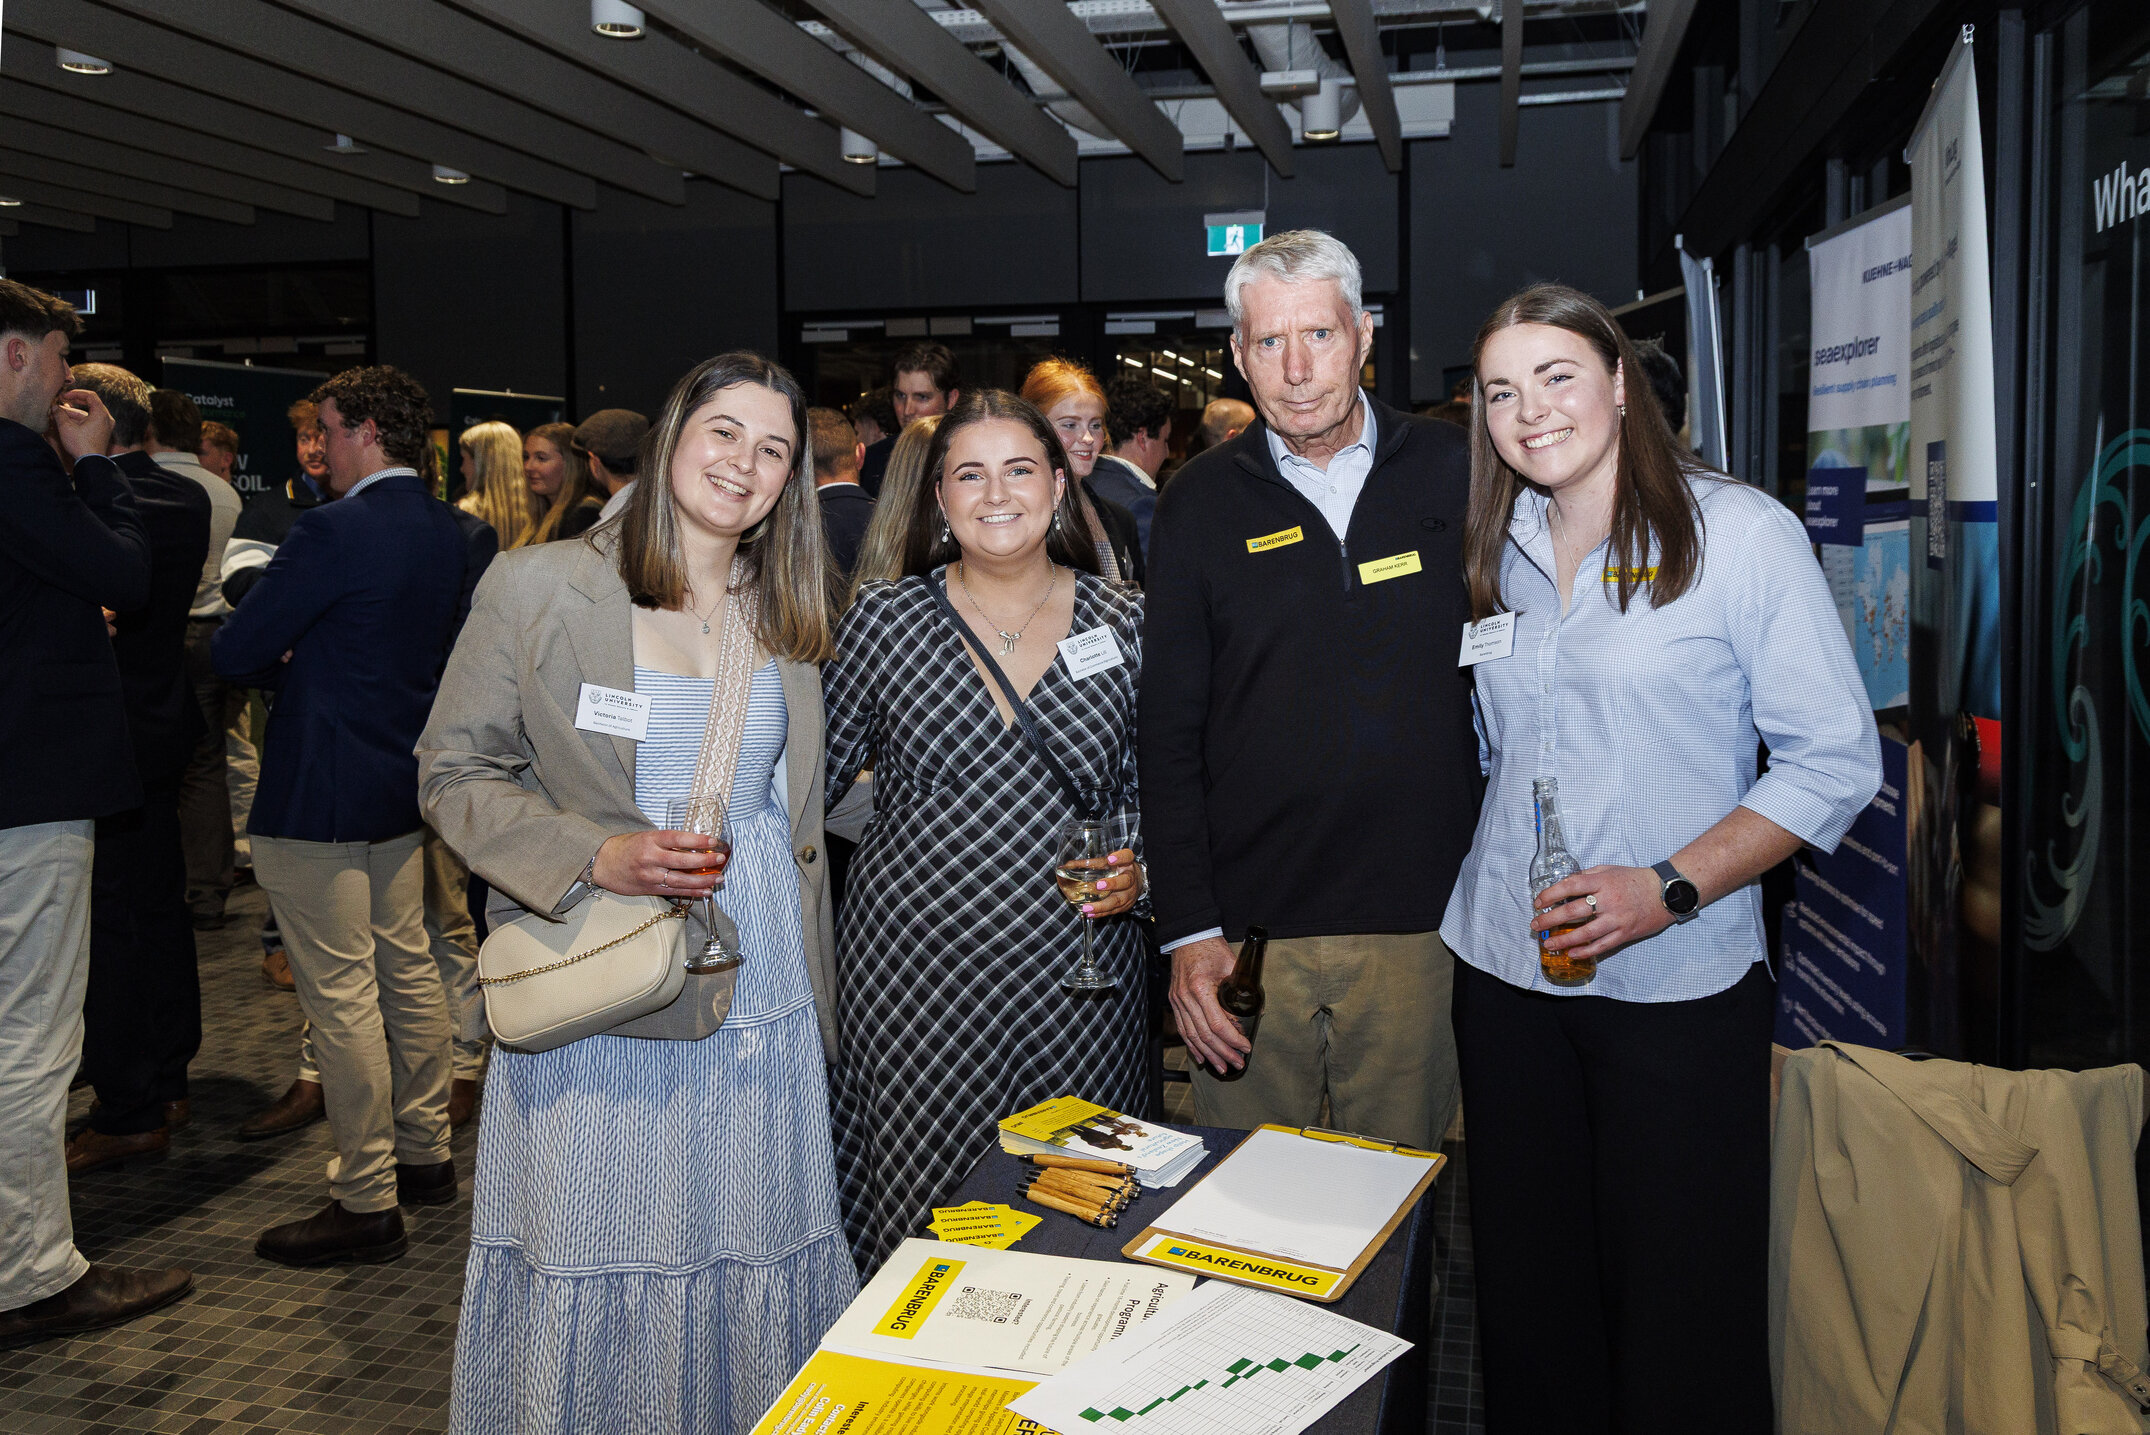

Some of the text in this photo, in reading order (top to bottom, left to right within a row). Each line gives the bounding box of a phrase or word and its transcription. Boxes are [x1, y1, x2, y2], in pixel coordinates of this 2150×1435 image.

[2094, 160, 2150, 233] Wha
[1814, 336, 1880, 366] seaexplorer
[1258, 532, 1298, 547] BARENBRUG
[1372, 564, 1393, 574] GRAHAM
[1480, 623, 1508, 632] UNIVERSITY
[1079, 635, 1107, 647] UNIVERSITY
[1080, 653, 1101, 663] Charlotte
[605, 698, 643, 708] UNIVERSITY
[606, 693, 632, 702] LINCOLN
[594, 710, 616, 720] Victoria
[943, 1224, 994, 1232] BARENBRUG
[946, 1234, 997, 1242] BARENBRUG
[1184, 1251, 1319, 1286] BARENBRUG
[891, 1272, 943, 1329] BARENBRUG
[1013, 1299, 1031, 1325] Interested?
[809, 1397, 830, 1417] Colin
[816, 1404, 845, 1435] Contact:
[837, 1402, 868, 1434] Intereste
